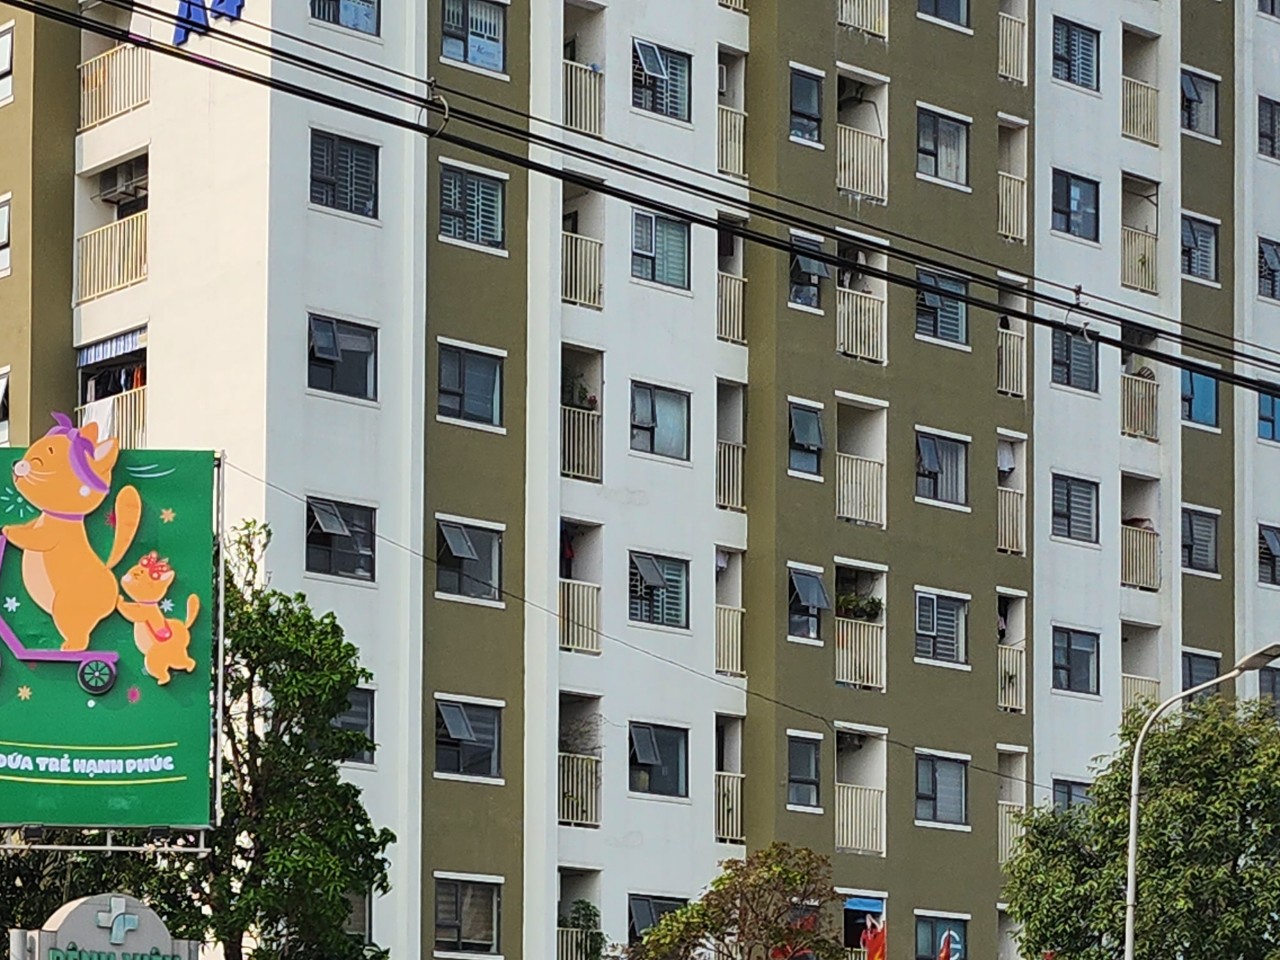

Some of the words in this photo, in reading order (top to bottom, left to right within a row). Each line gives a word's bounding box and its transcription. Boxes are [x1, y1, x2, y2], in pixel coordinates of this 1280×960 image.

[36, 753, 70, 773] TRẺ
[73, 757, 123, 777] HẠNH
[125, 753, 174, 773] PHÚC
